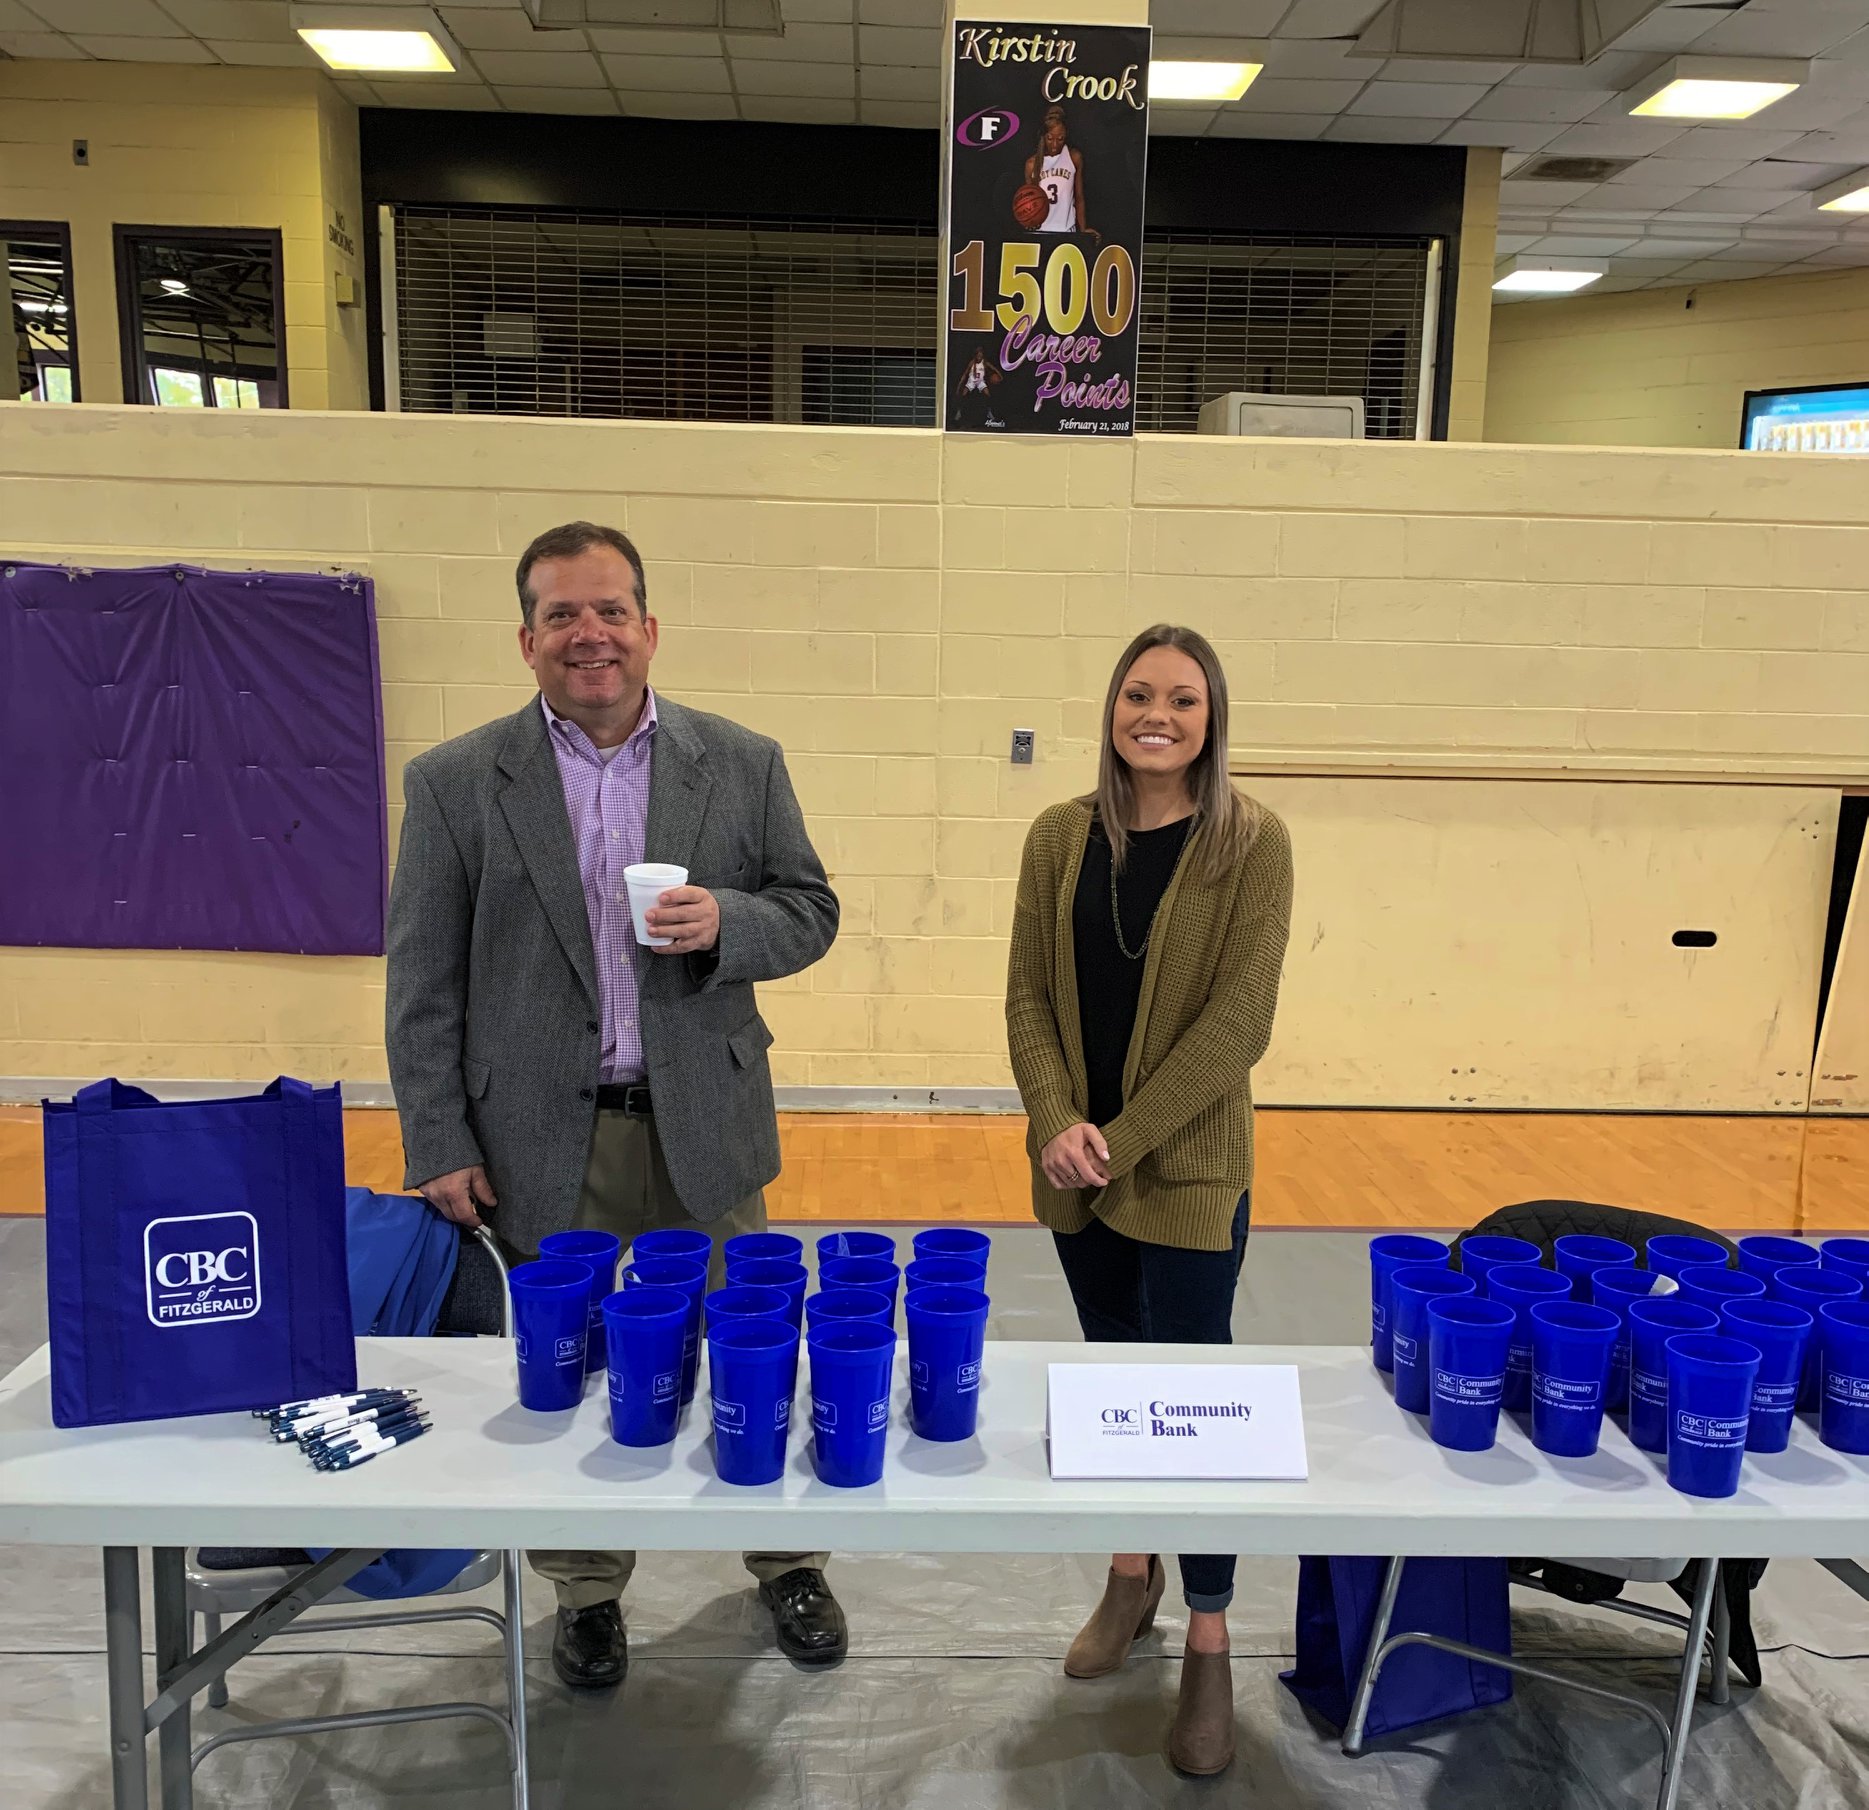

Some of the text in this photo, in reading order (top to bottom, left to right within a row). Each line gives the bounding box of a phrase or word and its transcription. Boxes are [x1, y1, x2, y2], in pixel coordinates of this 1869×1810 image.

[960, 27, 1077, 67] Kirstin
[1041, 64, 1144, 110] Crook
[980, 117, 1000, 140] F
[1047, 184, 1058, 205] 3
[335, 210, 345, 232] NO
[328, 223, 354, 256] SMOKING
[950, 240, 1136, 337] 1500
[999, 314, 1102, 371] Career
[1034, 361, 1131, 412] Points
[1058, 418, 1130, 433] February 21, 2018
[156, 1246, 247, 1288] CBC
[196, 1285, 216, 1302] of
[159, 1297, 254, 1318] FITZGERALD
[1437, 1372, 1456, 1385] CBC
[1544, 1377, 1593, 1395] Community
[1829, 1374, 1849, 1387] CBC
[1459, 1386, 1482, 1396] Bank
[1544, 1385, 1565, 1399] Bank
[1853, 1388, 1869, 1398] Ban
[1101, 1409, 1137, 1423] CBC
[1149, 1401, 1252, 1422] Community
[1151, 1419, 1198, 1436] Bank
[1682, 1415, 1704, 1428] CBC
[1707, 1428, 1731, 1438] Bank
